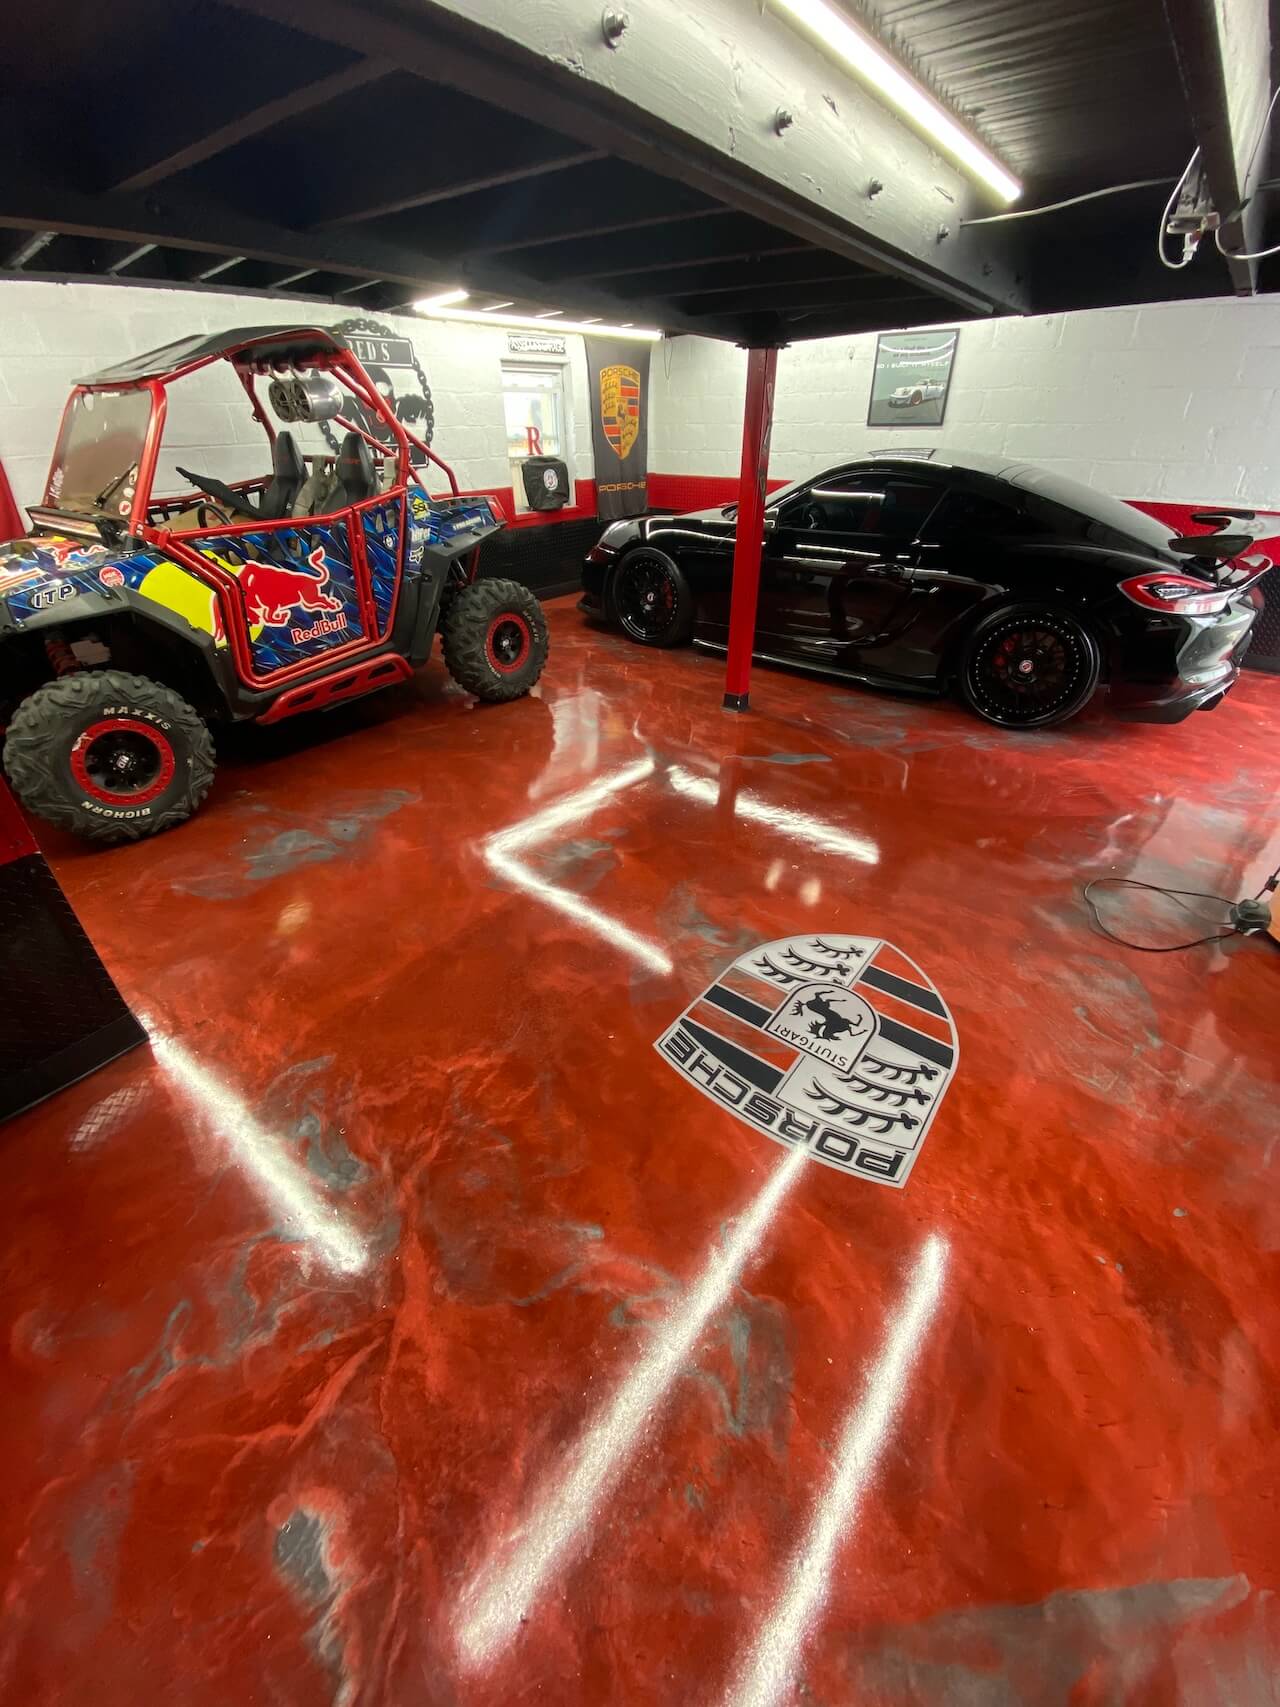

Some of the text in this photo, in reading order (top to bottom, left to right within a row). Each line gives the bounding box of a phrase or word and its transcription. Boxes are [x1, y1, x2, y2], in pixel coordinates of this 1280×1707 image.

[525, 426, 543, 455] R
[599, 481, 647, 492] PORSCHE
[34, 584, 73, 608] ITP
[103, 706, 173, 731] MAXXIS
[80, 799, 151, 818] BIGHORN
[772, 1024, 848, 1067] STUTTGART
[661, 1028, 906, 1178] PORSCHE
